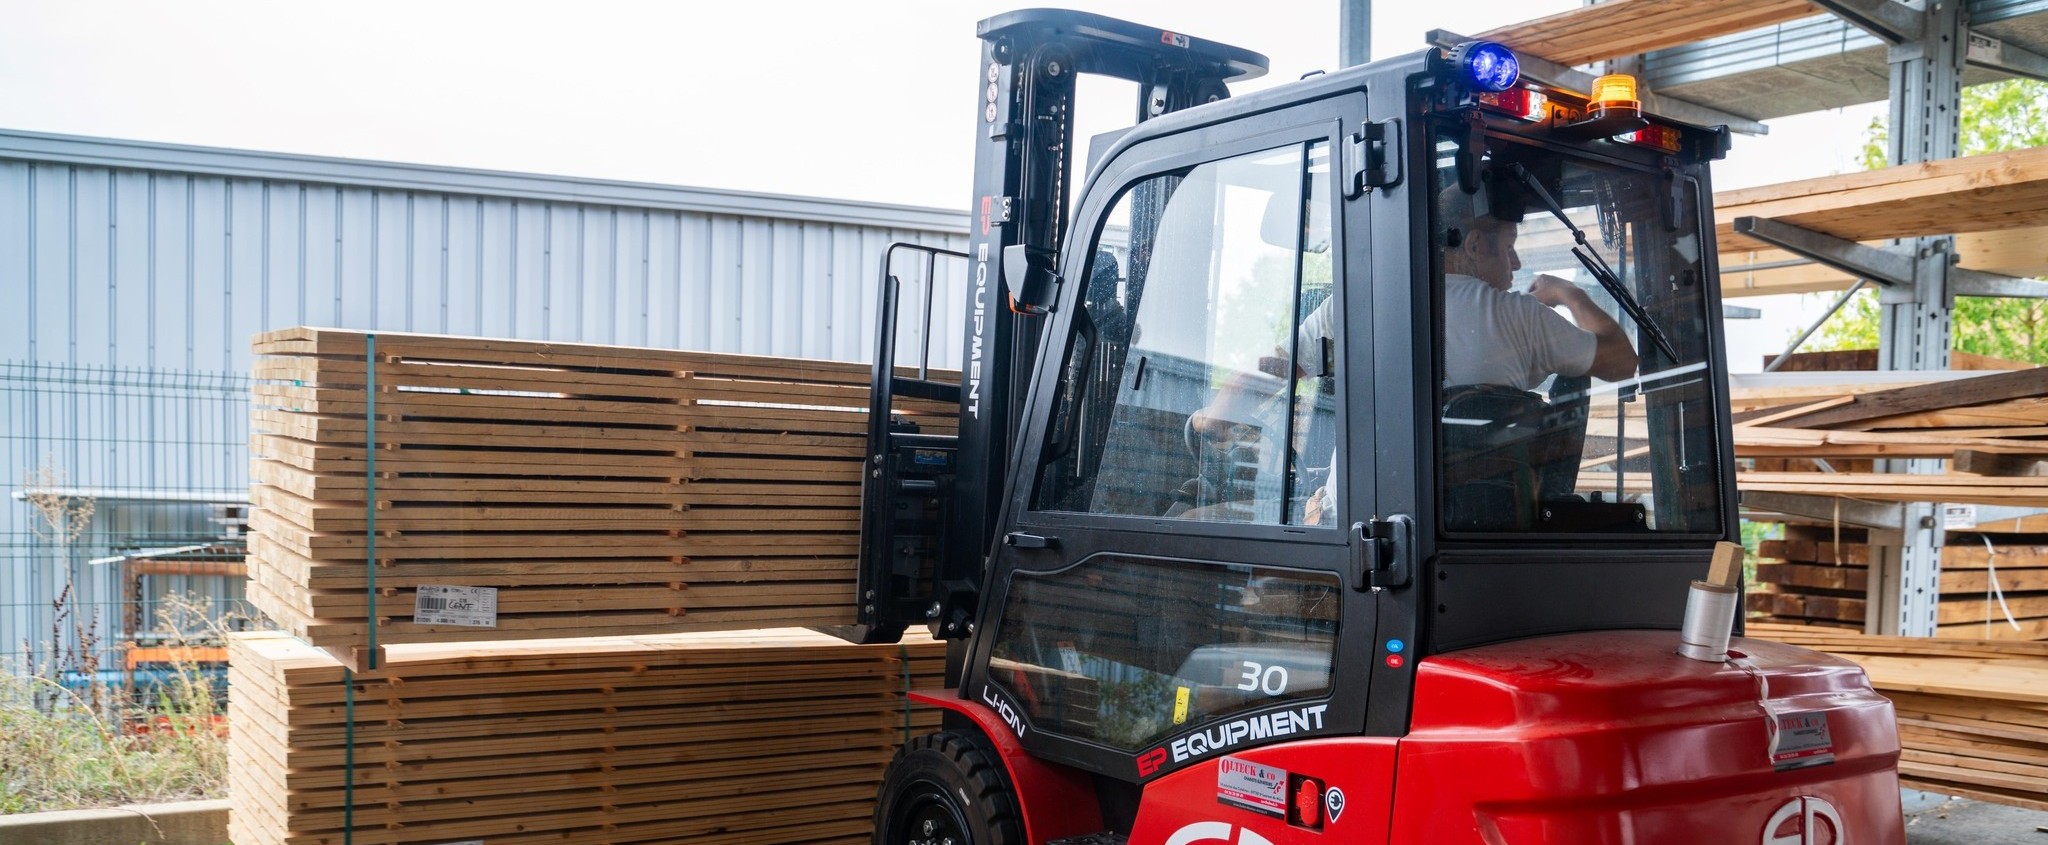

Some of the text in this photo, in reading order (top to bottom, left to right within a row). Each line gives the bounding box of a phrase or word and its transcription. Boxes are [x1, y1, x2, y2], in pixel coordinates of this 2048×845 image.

[968, 195, 992, 420] EP EQUIPMENT
[1236, 660, 1289, 696] 30
[1136, 747, 1168, 778] EP
[1171, 704, 1328, 763] EQUIPMENT
[1770, 717, 1803, 736] OTECK
[1221, 759, 1256, 776] OLTECK
[1259, 769, 1265, 778] &
